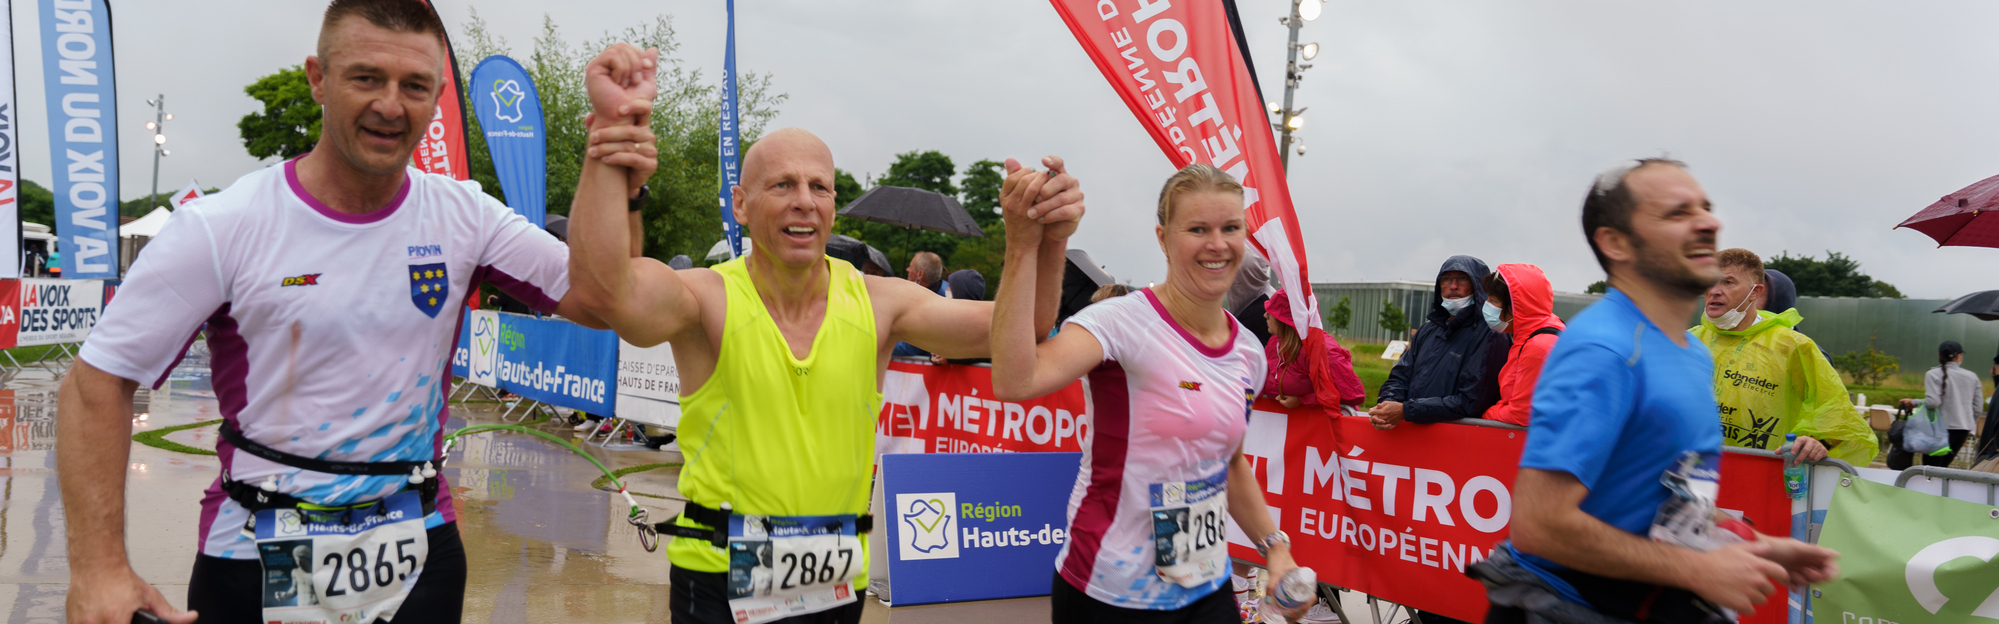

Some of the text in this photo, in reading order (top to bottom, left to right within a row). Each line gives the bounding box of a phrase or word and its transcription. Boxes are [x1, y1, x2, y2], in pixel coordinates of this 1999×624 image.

[723, 136, 735, 157] EN
[407, 244, 442, 257] PIOVIN
[281, 273, 323, 287] DSX
[23, 284, 71, 307] LA VOIX
[20, 307, 97, 333] DES SPORTS
[496, 352, 606, 404] Hauts-de-France
[645, 379, 656, 391] DE
[1723, 369, 1779, 391] Schneider
[1742, 383, 1776, 397] Electric
[1303, 445, 1512, 533] MÉTRO
[961, 501, 1022, 522] Région
[323, 538, 418, 598] 2865
[780, 548, 854, 590] 2867
